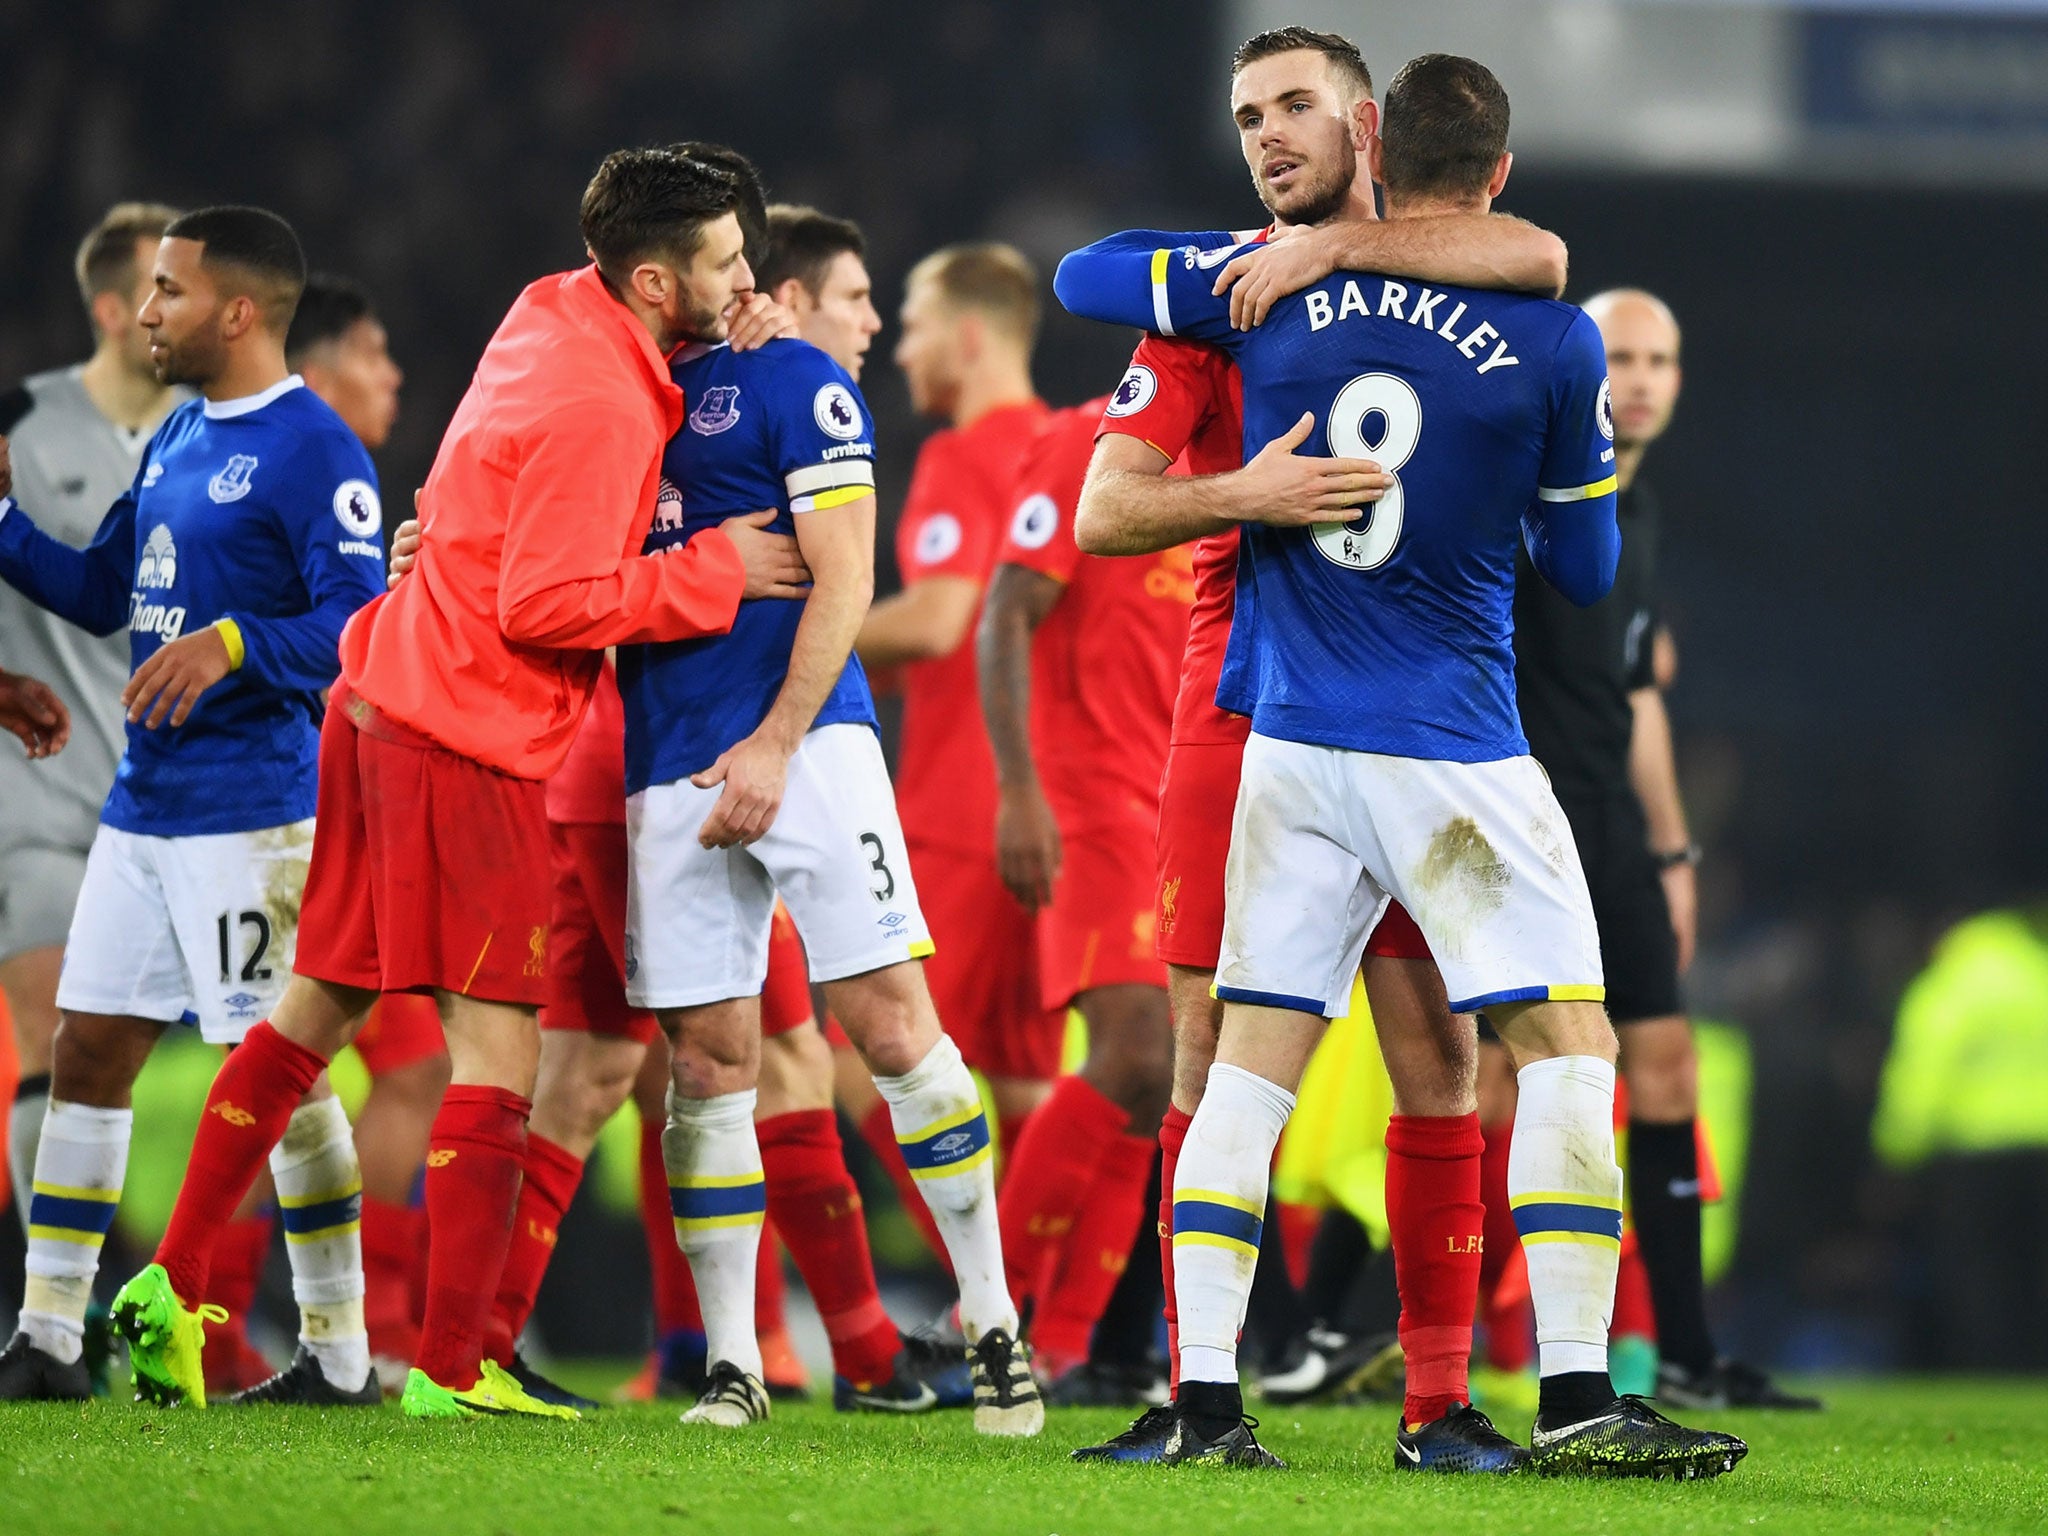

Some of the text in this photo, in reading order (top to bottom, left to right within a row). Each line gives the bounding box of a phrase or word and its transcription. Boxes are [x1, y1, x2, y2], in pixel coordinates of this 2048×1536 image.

[1304, 280, 1520, 375] BARKLEY
[822, 441, 872, 460] umbro
[1308, 372, 1422, 570] 8
[338, 540, 382, 560] umbro
[857, 830, 895, 904] 3
[218, 910, 273, 983] 12
[883, 927, 909, 939] umbro
[1159, 921, 1176, 934] LFC
